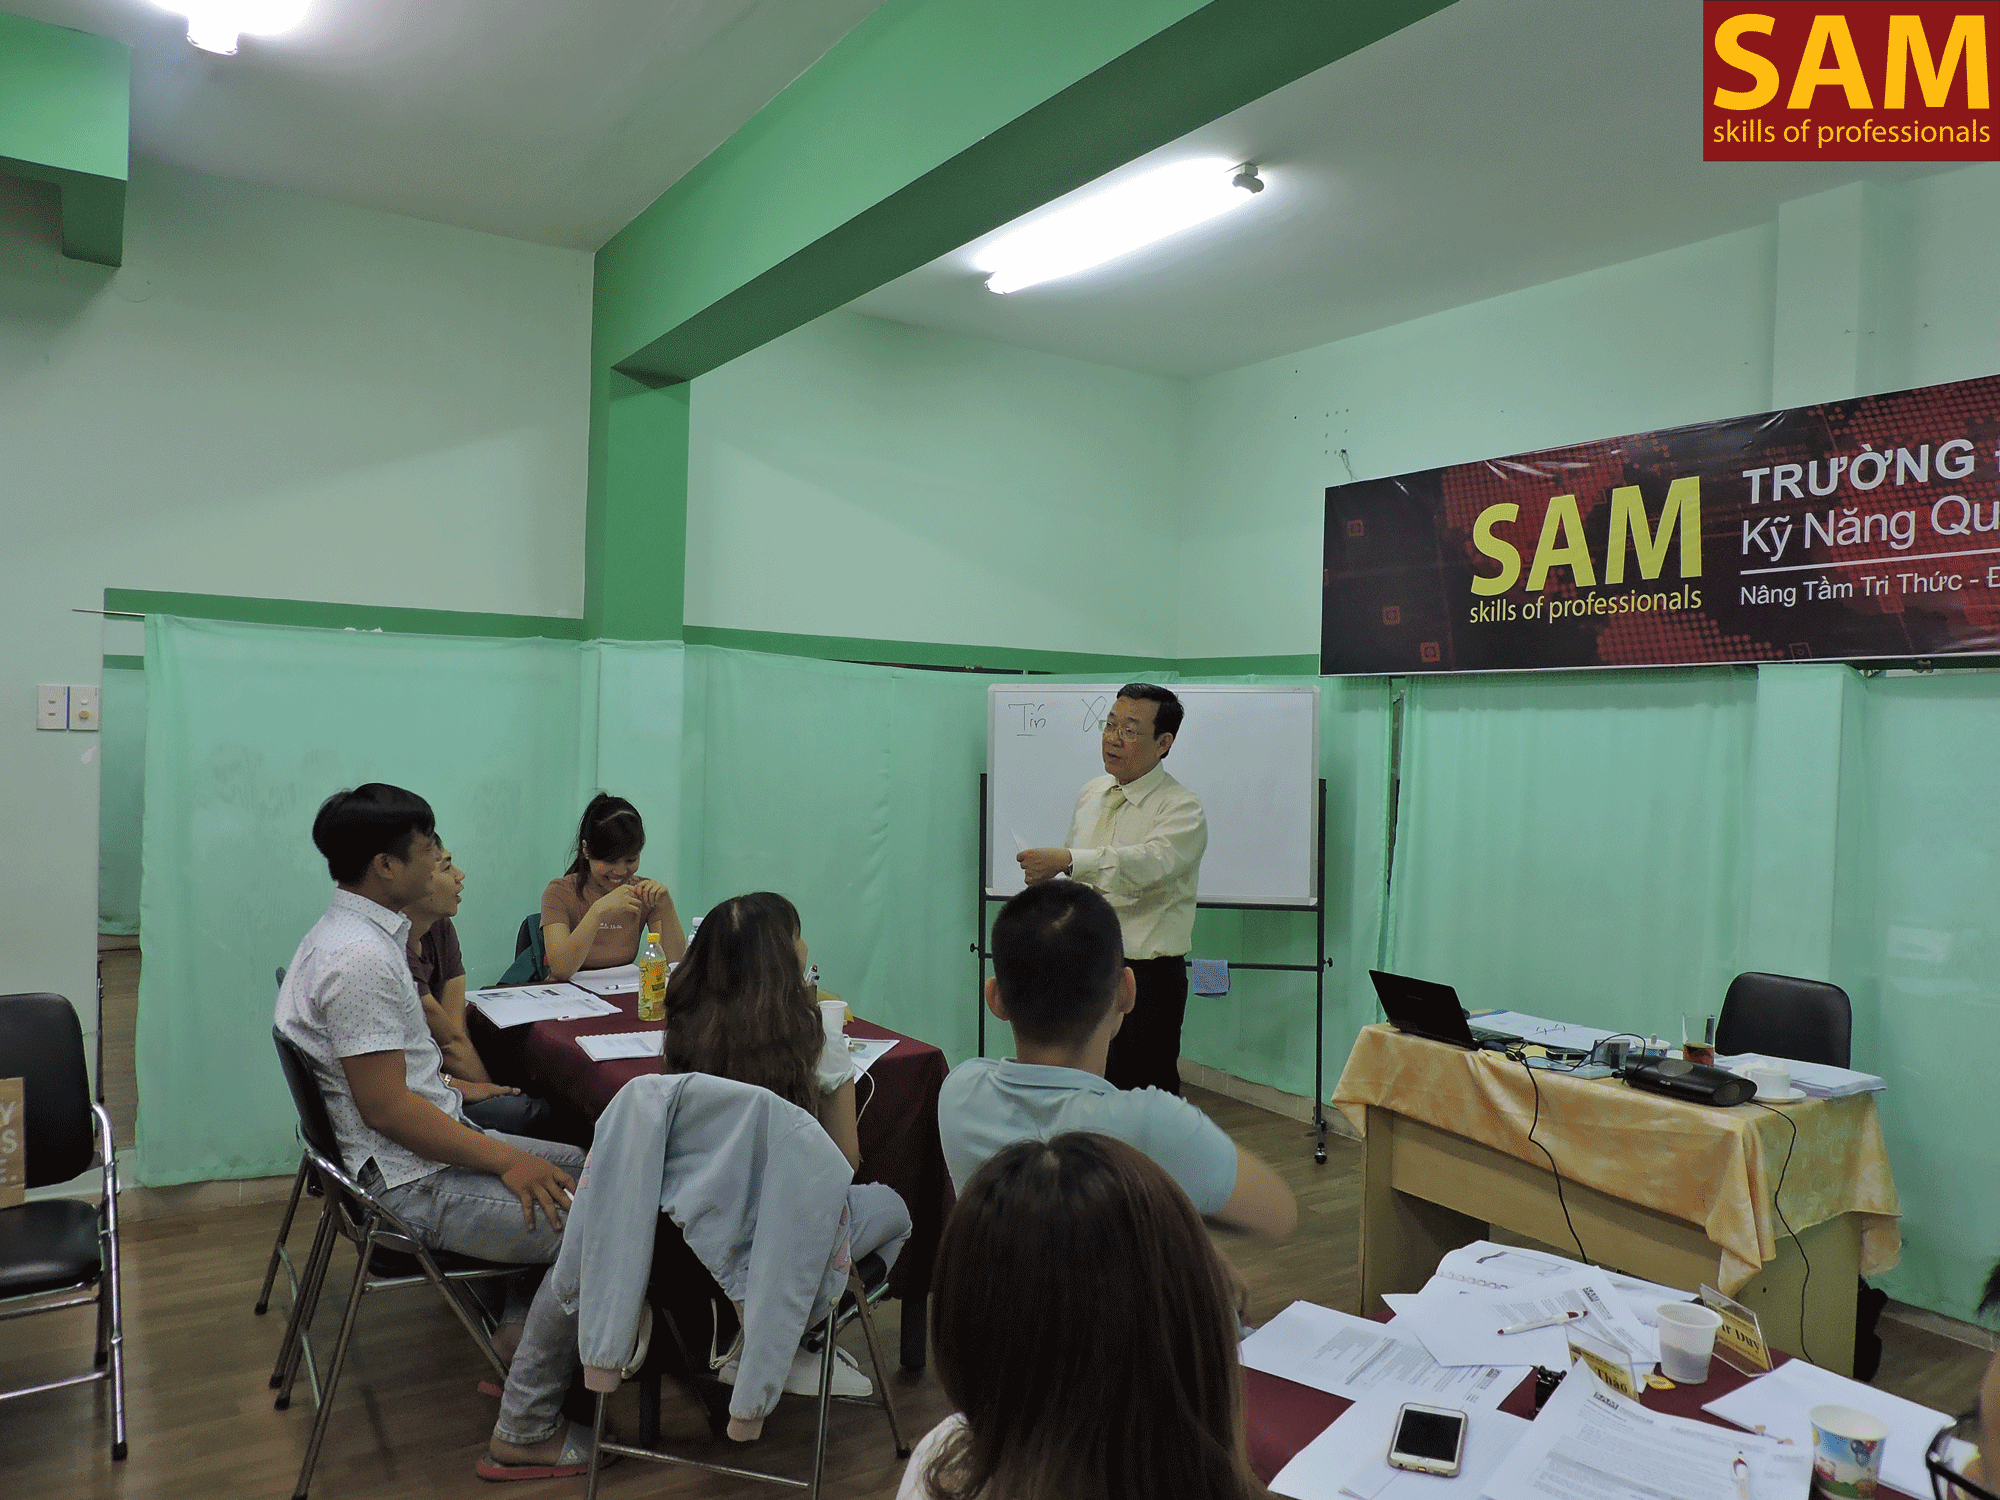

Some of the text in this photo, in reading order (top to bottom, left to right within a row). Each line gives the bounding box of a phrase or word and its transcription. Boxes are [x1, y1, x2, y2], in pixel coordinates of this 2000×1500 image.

[1742, 439, 1975, 504] TRƯỜNG
[1470, 476, 1702, 597] SAM
[1742, 515, 1793, 562] Kỹ
[1804, 507, 1916, 550] Năng
[1470, 584, 1702, 624] skills of professionals
[1740, 585, 1797, 608] Nâng
[1803, 576, 1853, 600] Tầm
[1860, 574, 1890, 596] Tri
[1896, 571, 1963, 593] Thức
